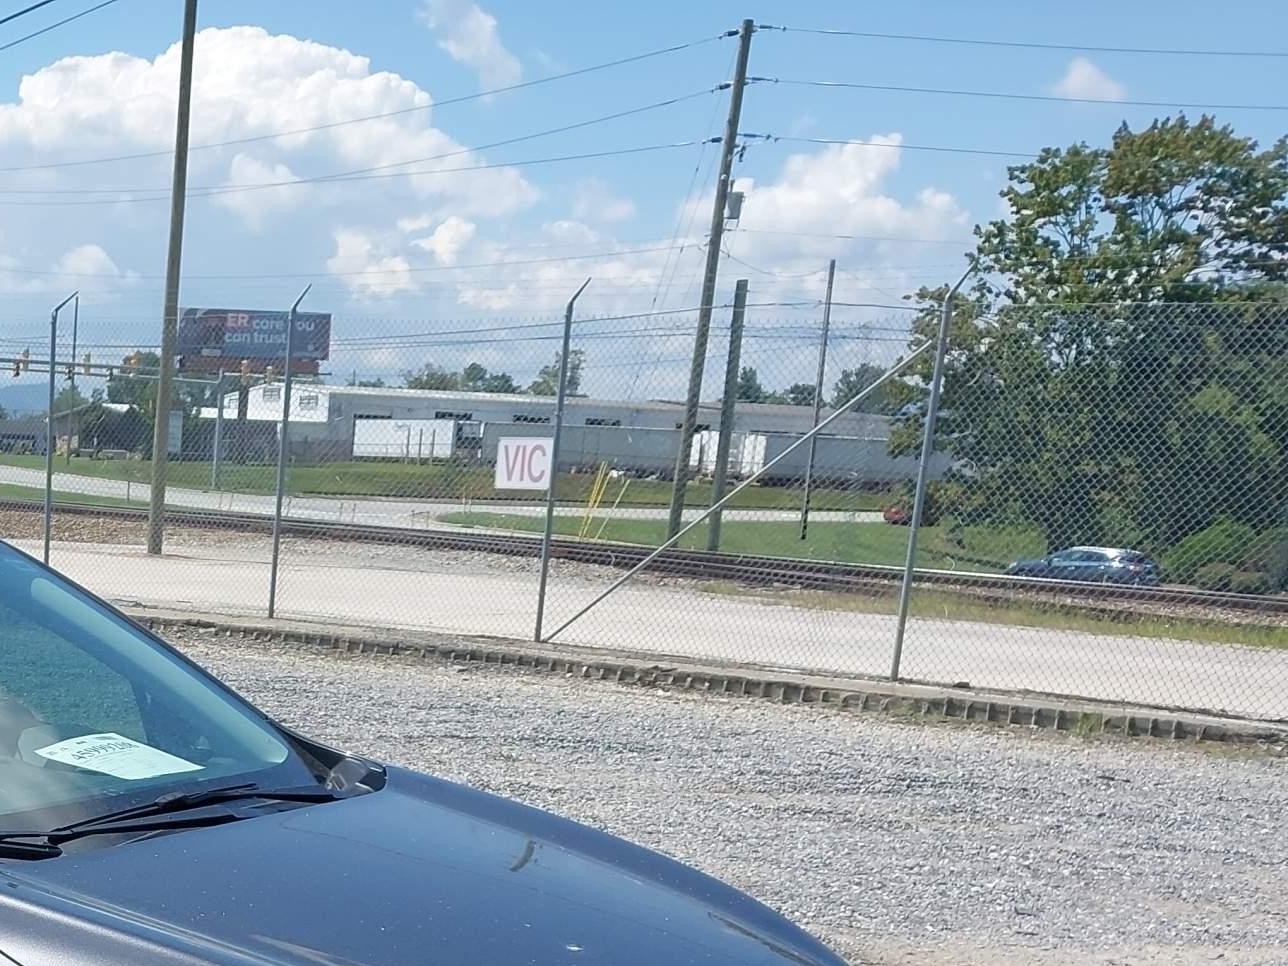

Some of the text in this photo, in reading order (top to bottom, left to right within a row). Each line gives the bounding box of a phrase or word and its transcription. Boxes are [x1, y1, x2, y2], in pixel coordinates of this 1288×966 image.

[226, 313, 249, 327] ER
[252, 319, 285, 330] care
[224, 332, 250, 343] can
[504, 444, 546, 483] VIC
